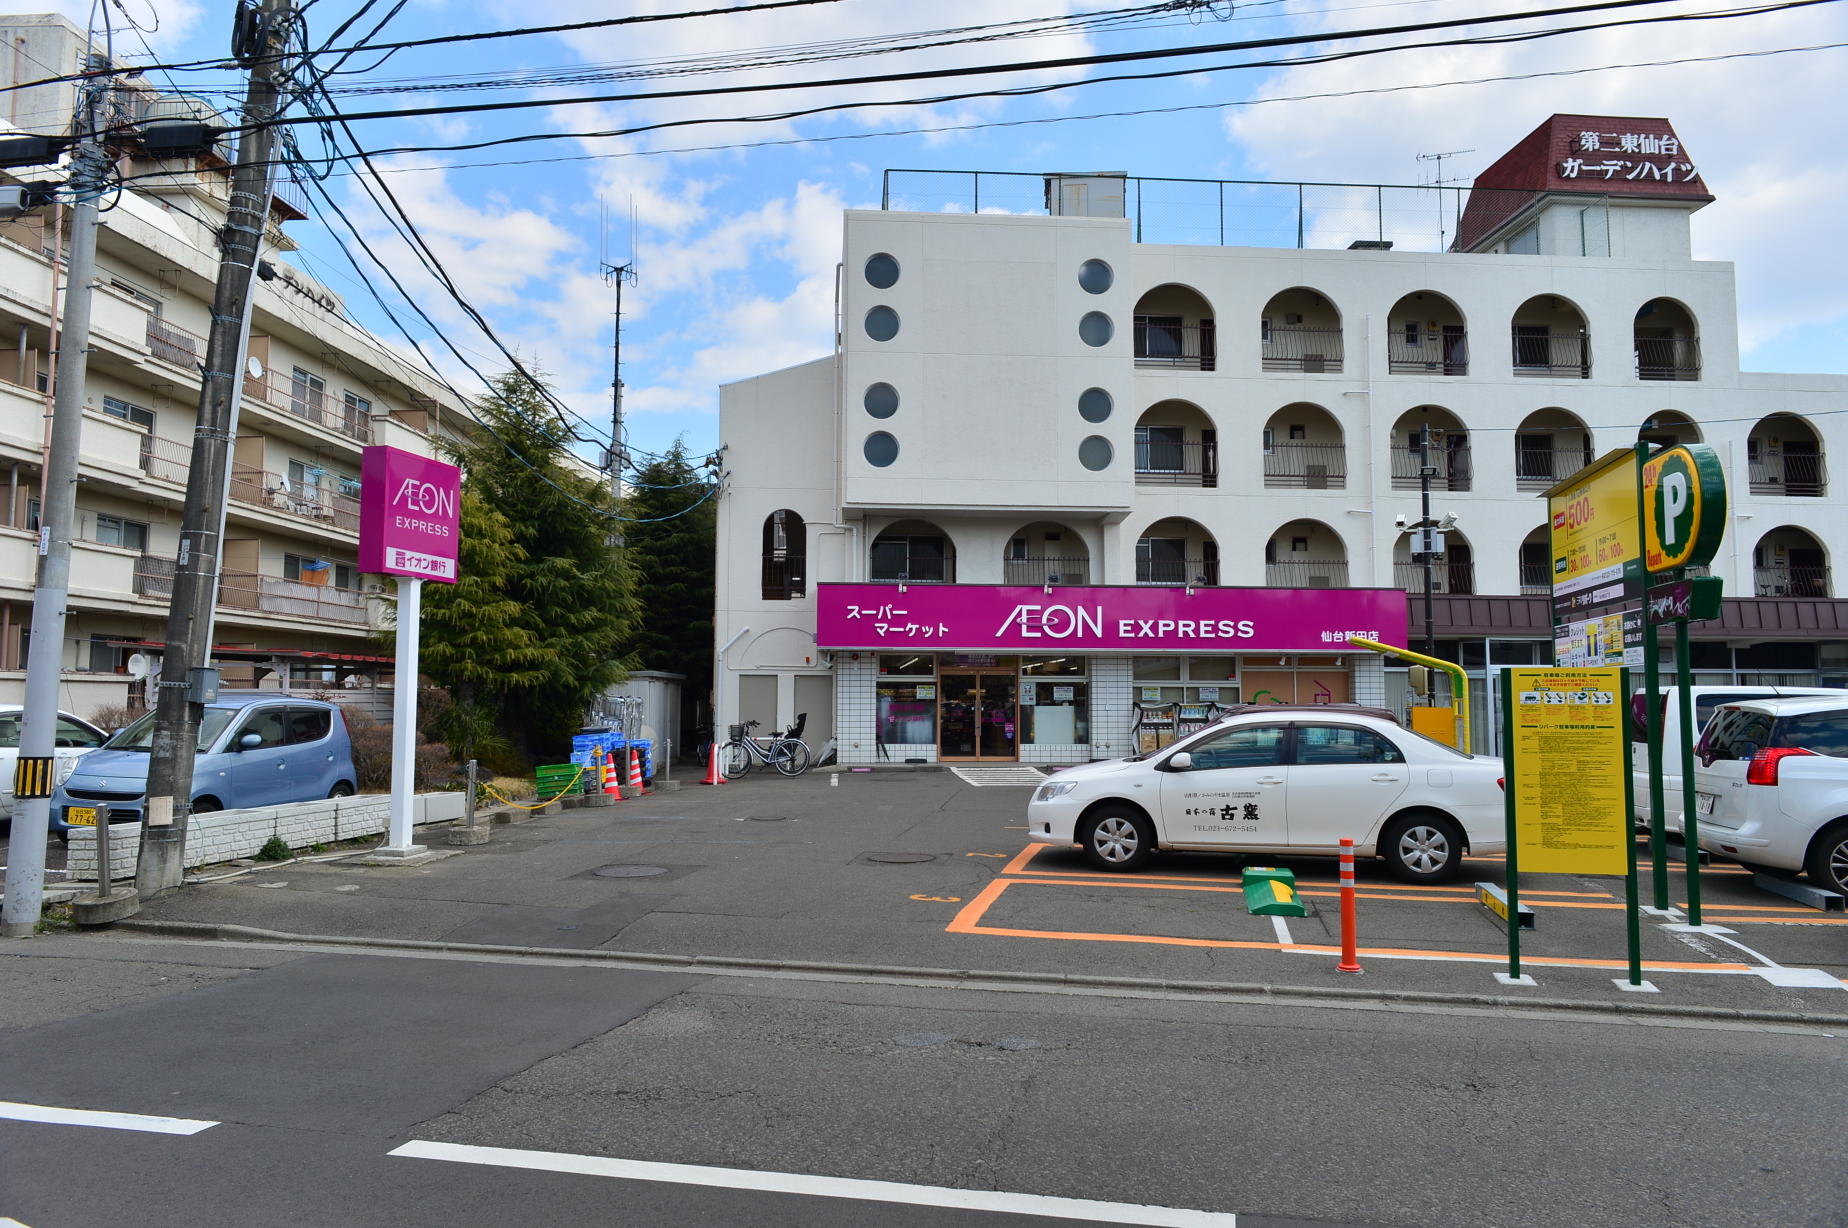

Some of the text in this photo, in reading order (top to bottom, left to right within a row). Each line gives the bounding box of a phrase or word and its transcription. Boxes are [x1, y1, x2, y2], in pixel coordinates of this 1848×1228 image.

[1579, 131, 1679, 154] 第二東仙台
[1562, 157, 1699, 182] ガーデンハイツ
[1662, 471, 1687, 546] P
[396, 516, 449, 536] EXPRESS
[407, 556, 446, 573] イオン銀行
[847, 604, 908, 620] スーパー
[874, 622, 949, 638] マーケット
[1118, 619, 1255, 638] EXPRESS
[1321, 630, 1379, 642] 仙台新田店
[74, 814, 96, 825] 77-62
